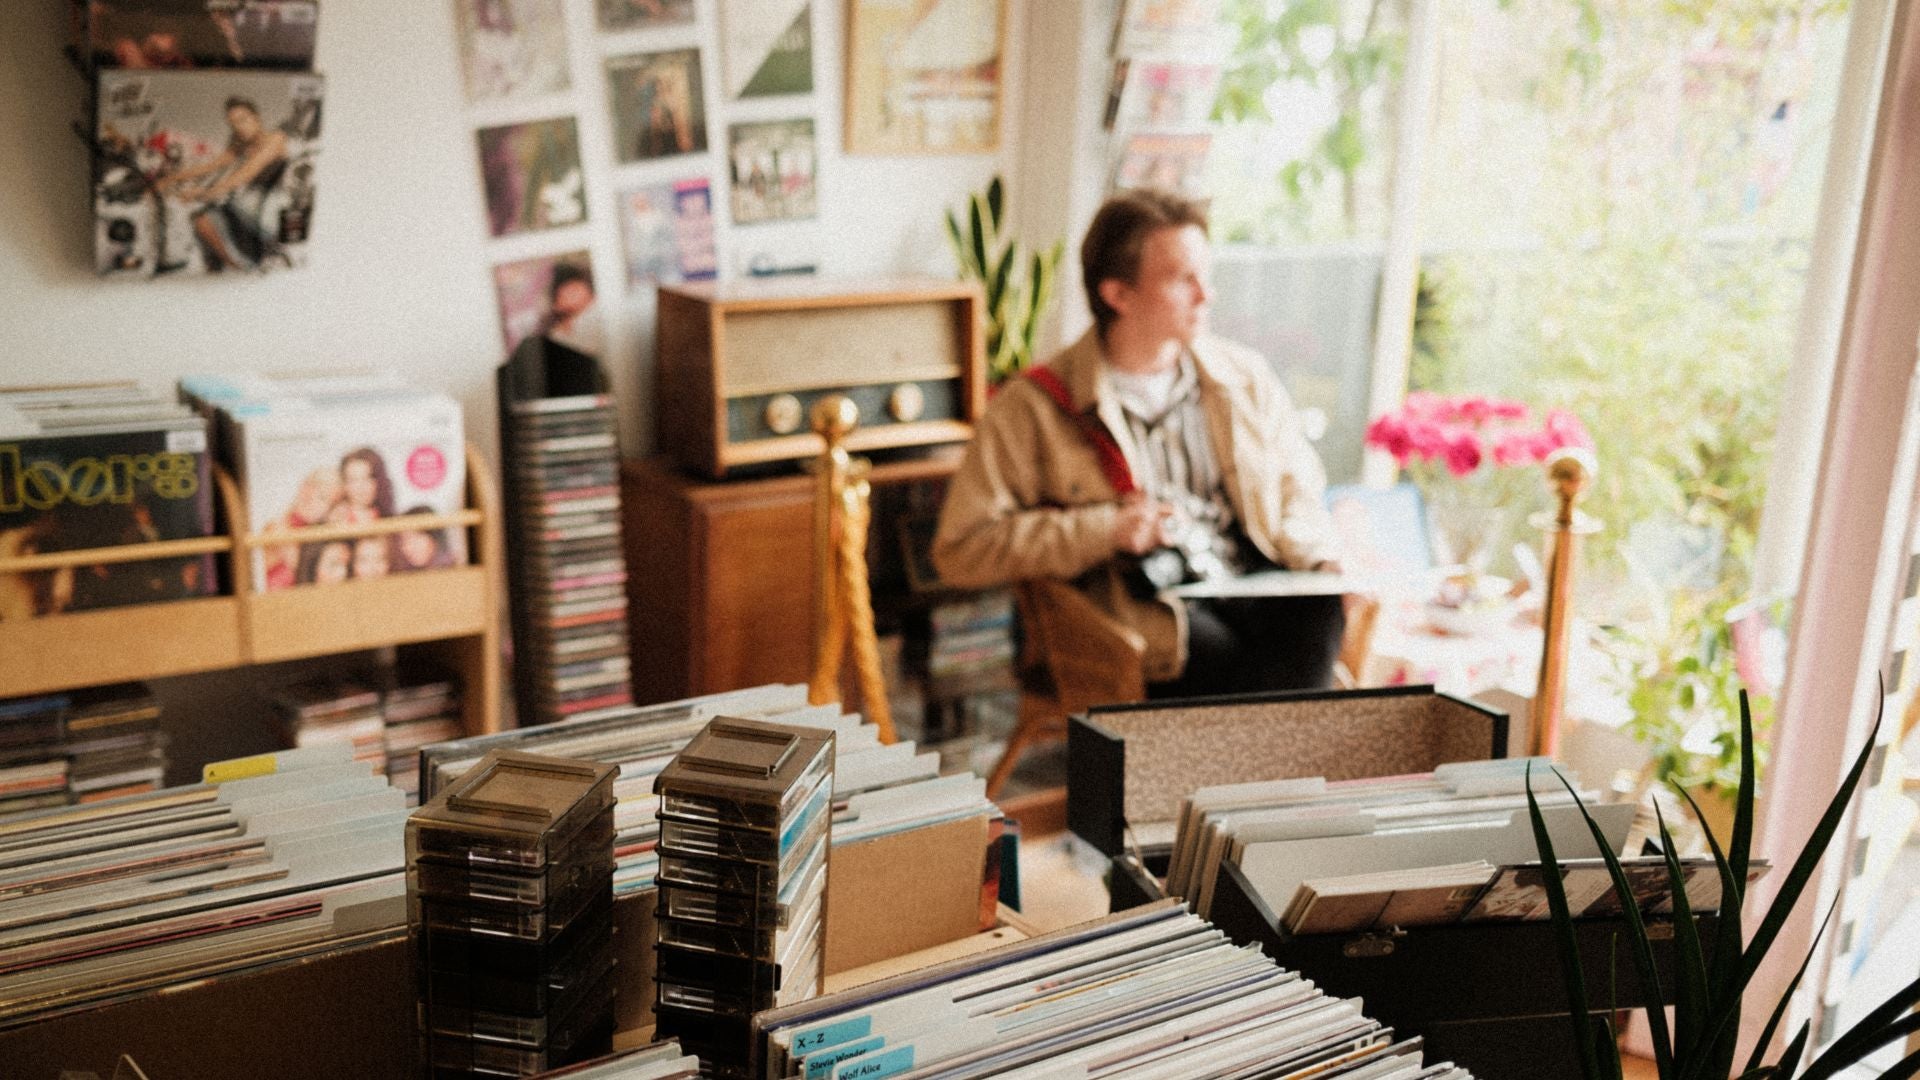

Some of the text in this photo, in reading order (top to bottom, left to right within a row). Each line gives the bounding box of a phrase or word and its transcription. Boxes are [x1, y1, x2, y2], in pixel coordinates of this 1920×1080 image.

[798, 1038, 806, 1048] X
[816, 1033, 825, 1043] Z
[810, 1049, 866, 1070] Stevie Wonder
[839, 1064, 881, 1080] Wolf Alice
